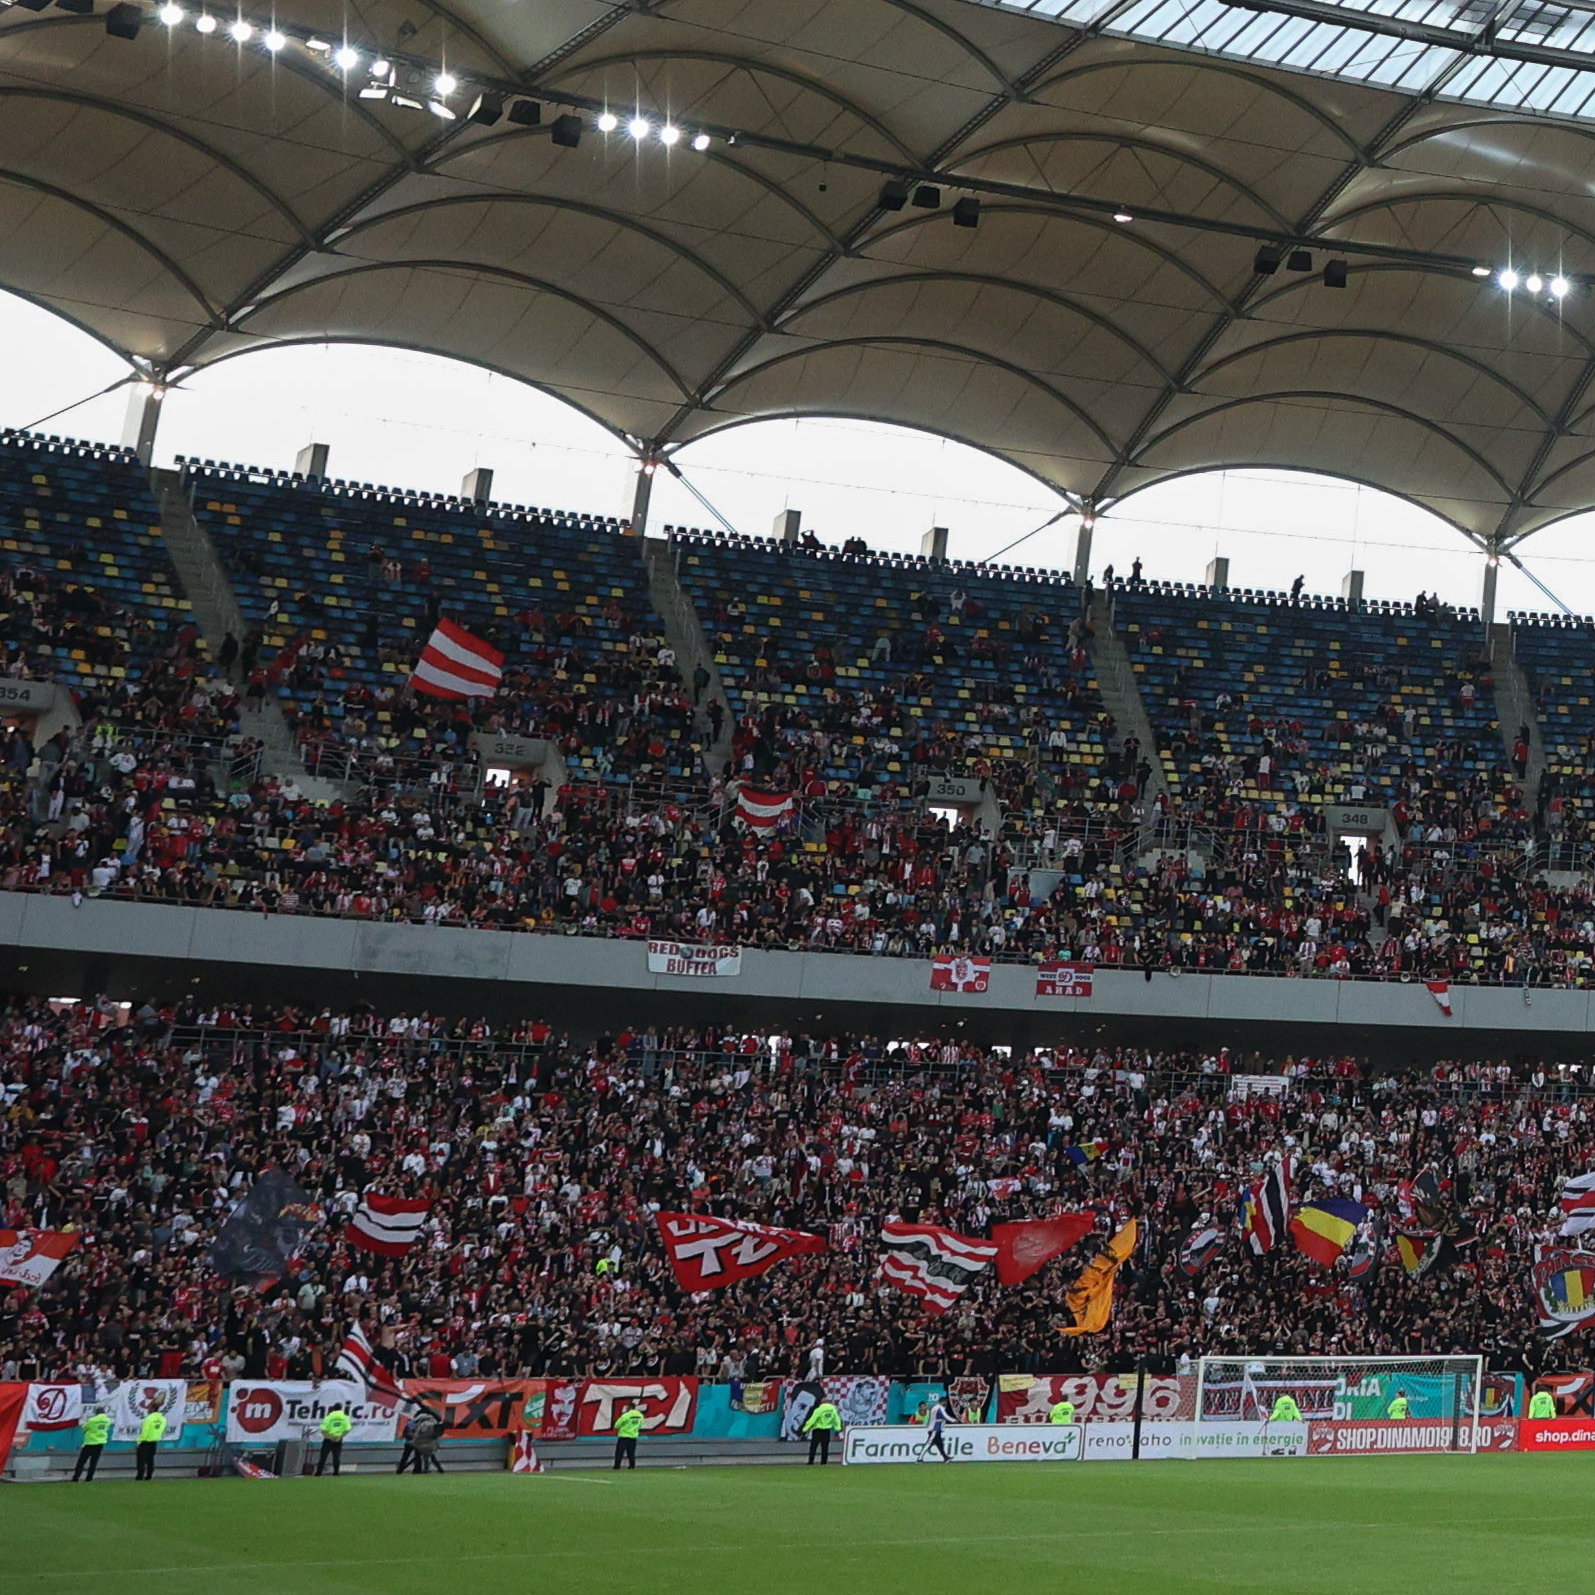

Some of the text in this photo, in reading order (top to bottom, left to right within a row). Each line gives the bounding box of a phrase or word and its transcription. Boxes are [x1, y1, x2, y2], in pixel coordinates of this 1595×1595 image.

[936, 784, 966, 796] 350
[648, 942, 739, 959] RED DOGS
[666, 959, 718, 975] BUFTEA
[286, 1399, 395, 1420] Tehic.ro
[851, 1436, 1066, 1457] Farmacile Beneva
[1253, 1432, 1304, 1450] energie
[1336, 1425, 1492, 1450] SHOP.DINAMO198.RO
